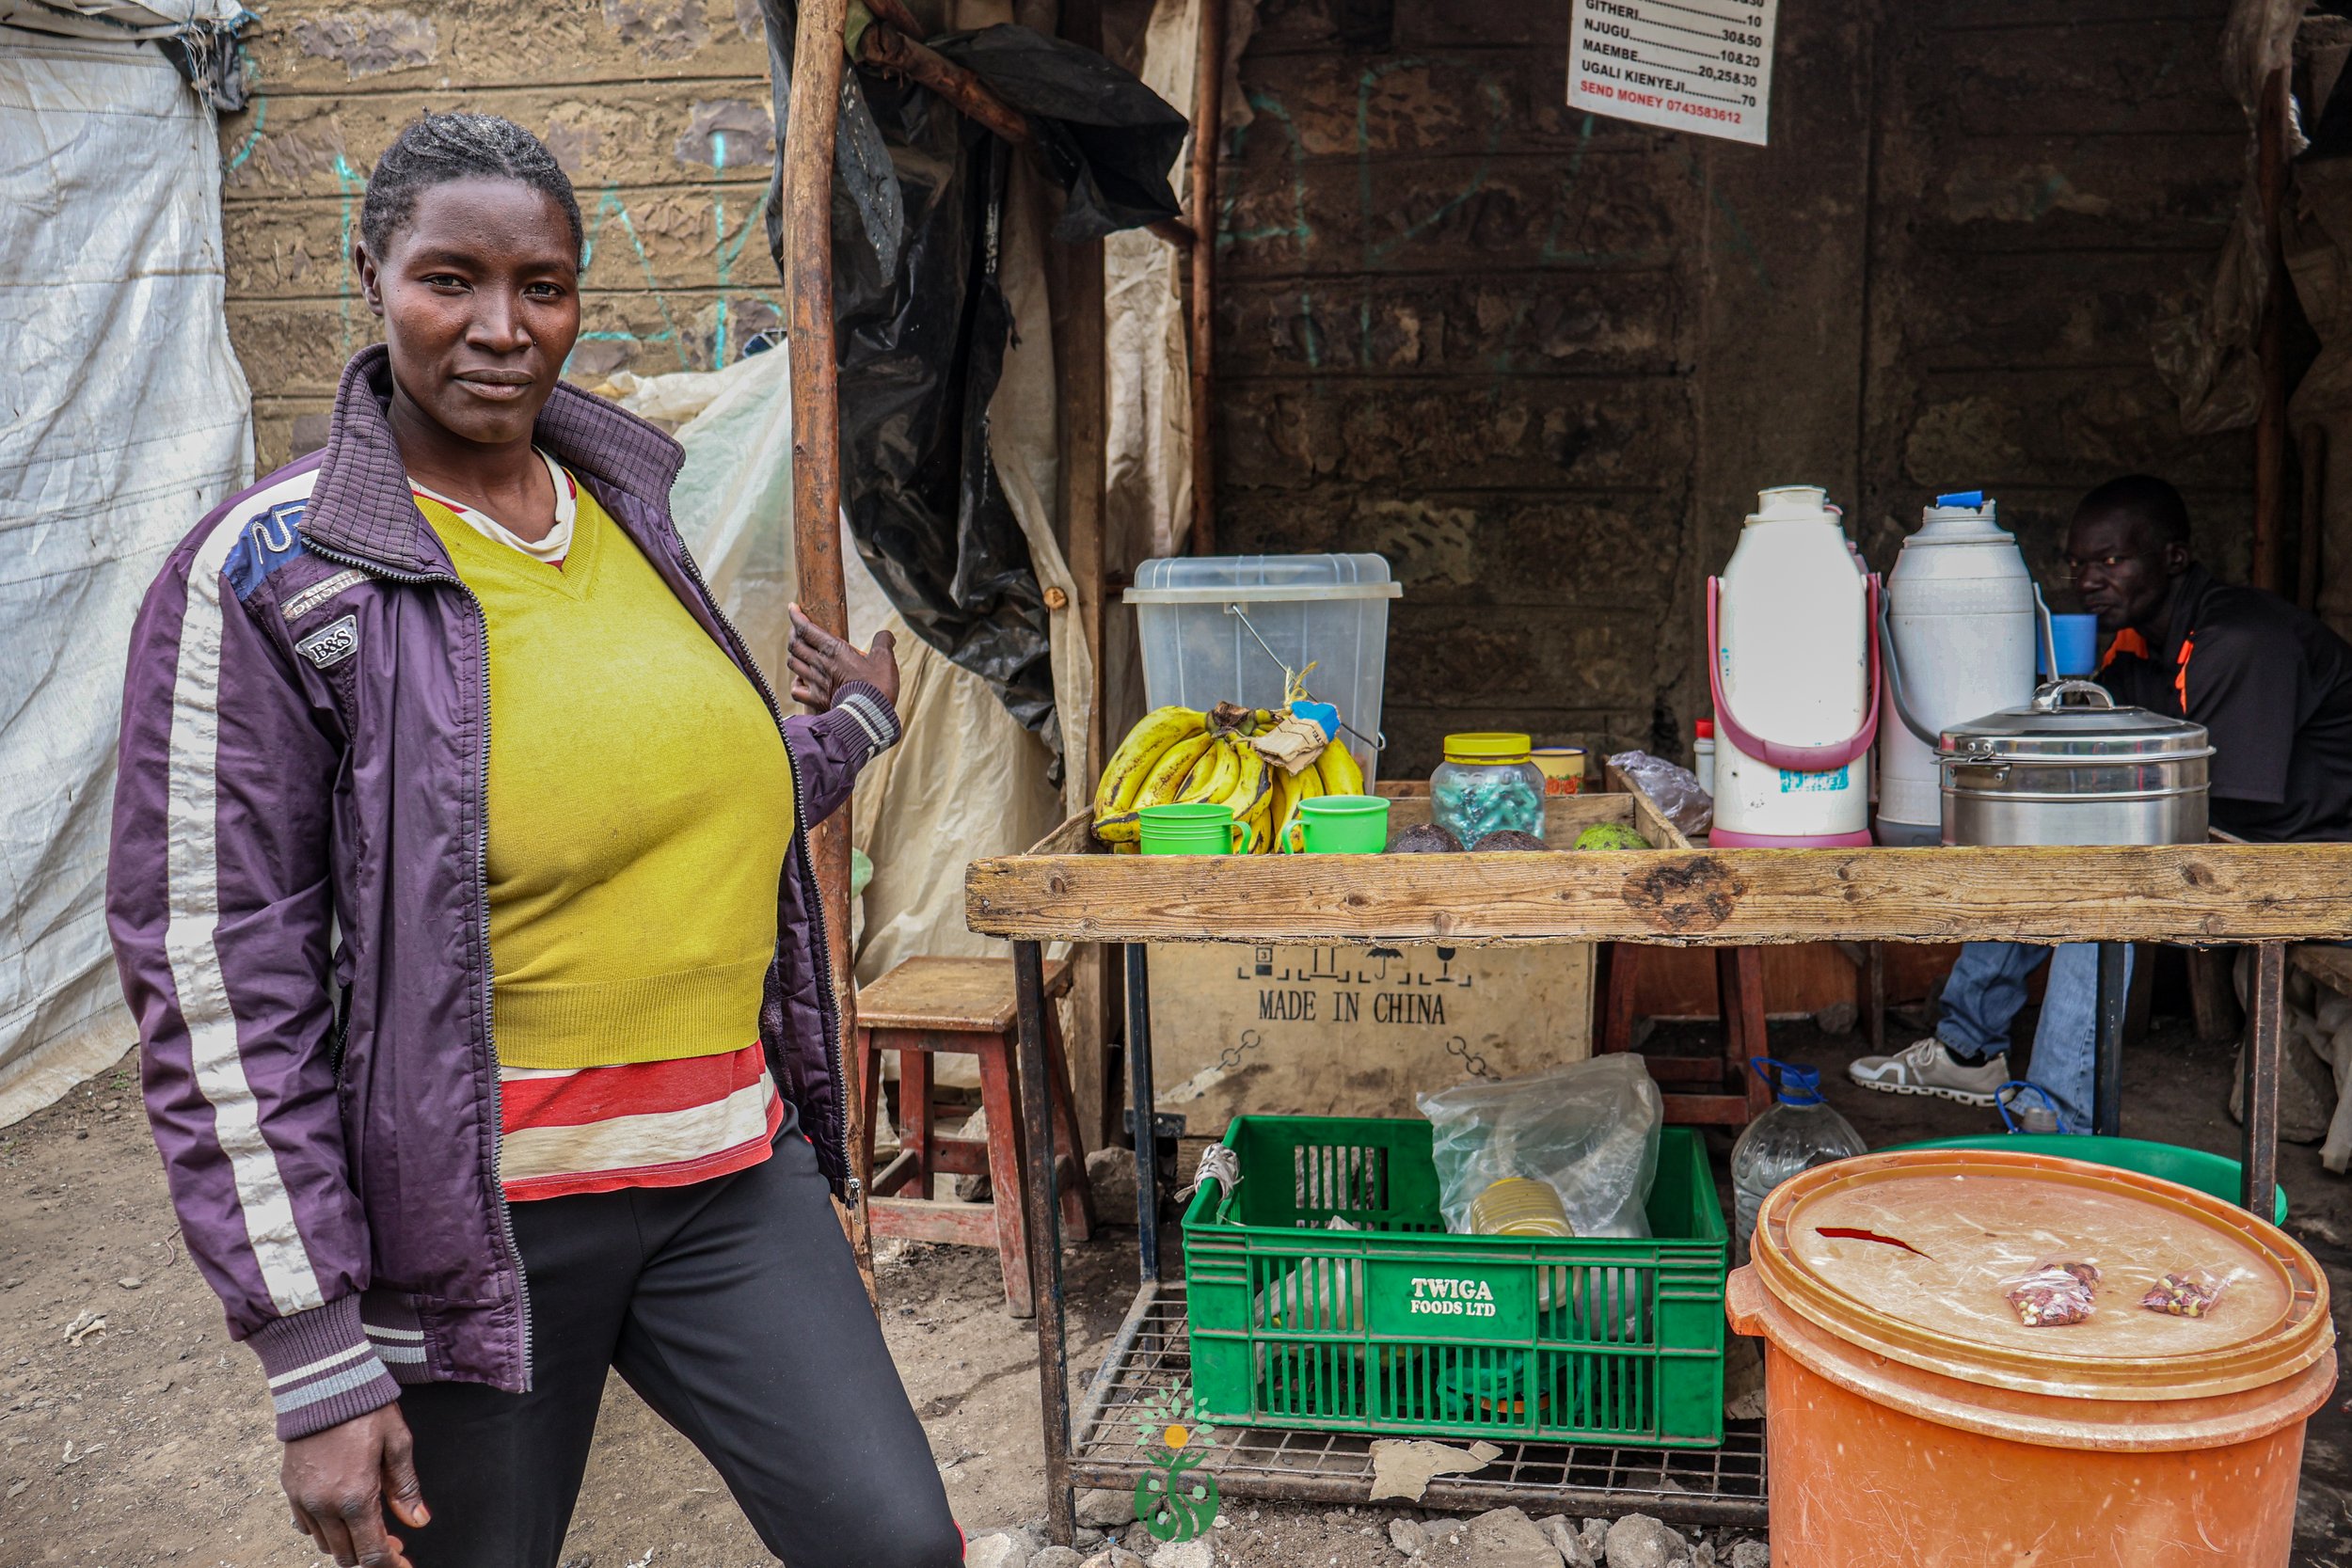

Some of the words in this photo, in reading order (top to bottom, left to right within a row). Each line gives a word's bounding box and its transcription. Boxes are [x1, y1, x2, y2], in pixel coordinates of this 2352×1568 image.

[1585, 0, 1639, 20] GITHERI
[1723, 29, 1762, 48] 30&50
[1582, 39, 1638, 62] MAEMBE
[1584, 18, 1629, 40] NJUGU
[1720, 50, 1760, 69] 10&20
[1581, 59, 1621, 79] UGALI
[1625, 71, 1685, 93] KIENYEJI
[1741, 94, 1756, 107] 70
[1581, 80, 1614, 98] SEND
[1617, 89, 1662, 108] MONEY
[309, 628, 353, 662] B&S
[1259, 990, 1316, 1022] MADE
[1332, 990, 1361, 1022] IN
[1373, 992, 1446, 1025] CHINA
[1411, 1278, 1494, 1301] TWIGA
[1410, 1300, 1463, 1315] FOODS
[1466, 1302, 1497, 1317] LTD
